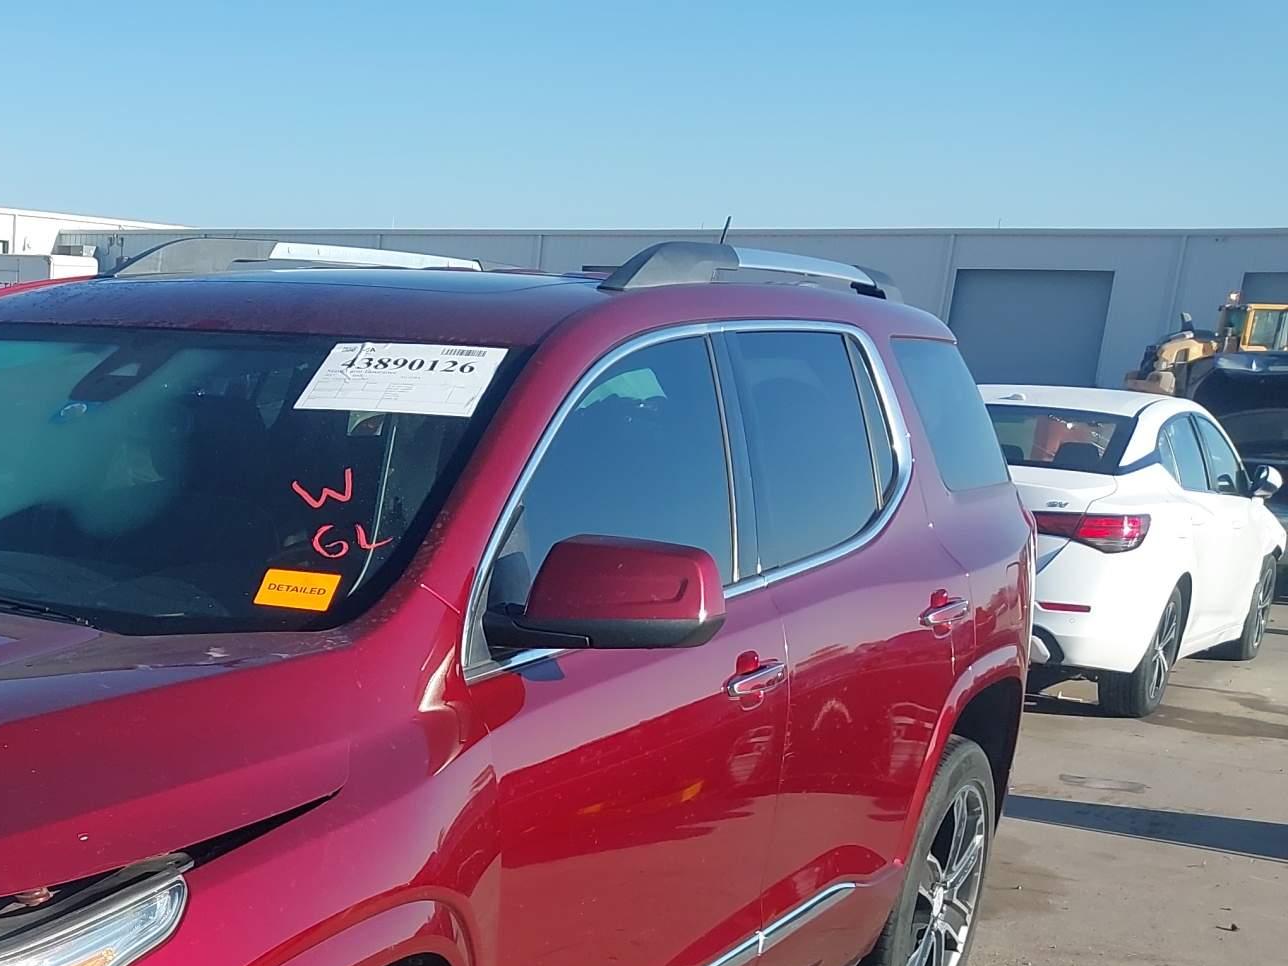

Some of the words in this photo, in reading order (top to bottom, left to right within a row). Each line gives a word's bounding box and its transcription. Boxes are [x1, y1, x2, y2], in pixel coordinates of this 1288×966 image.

[341, 357, 476, 374] 43890126
[292, 468, 352, 508] W
[267, 582, 327, 597] DETAILED
